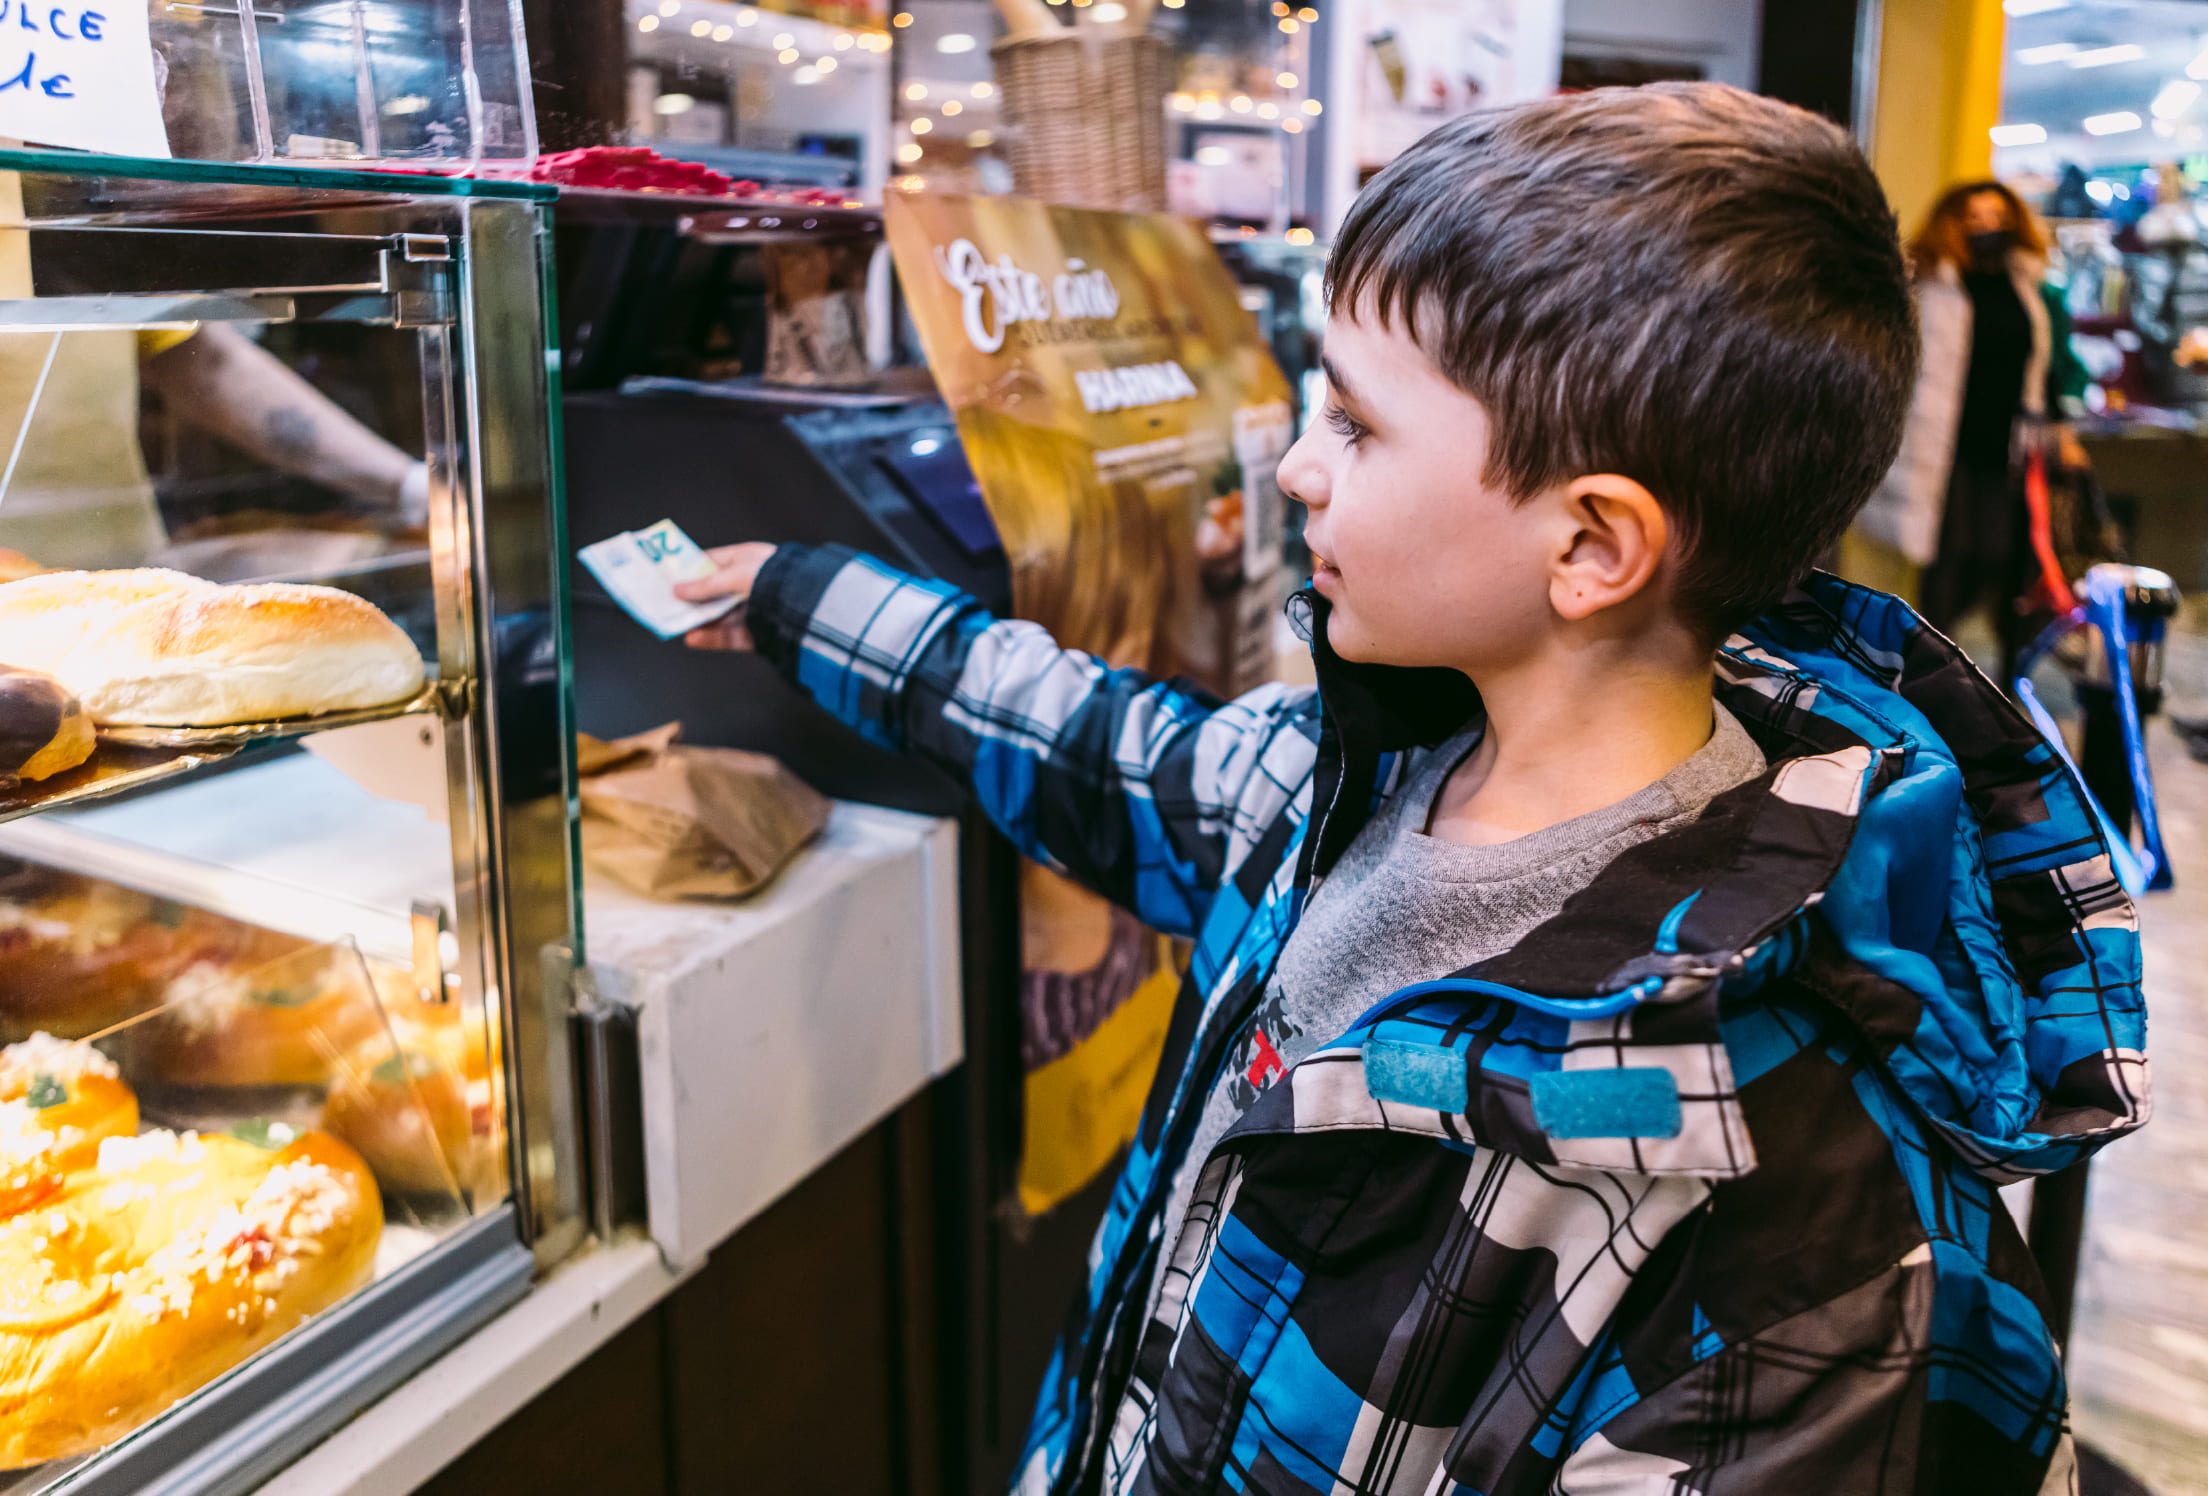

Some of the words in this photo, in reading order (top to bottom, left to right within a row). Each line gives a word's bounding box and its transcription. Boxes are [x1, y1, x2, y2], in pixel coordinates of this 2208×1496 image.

[934, 238, 1051, 353] Este
[1053, 256, 1120, 319] año
[636, 530, 683, 564] 20
